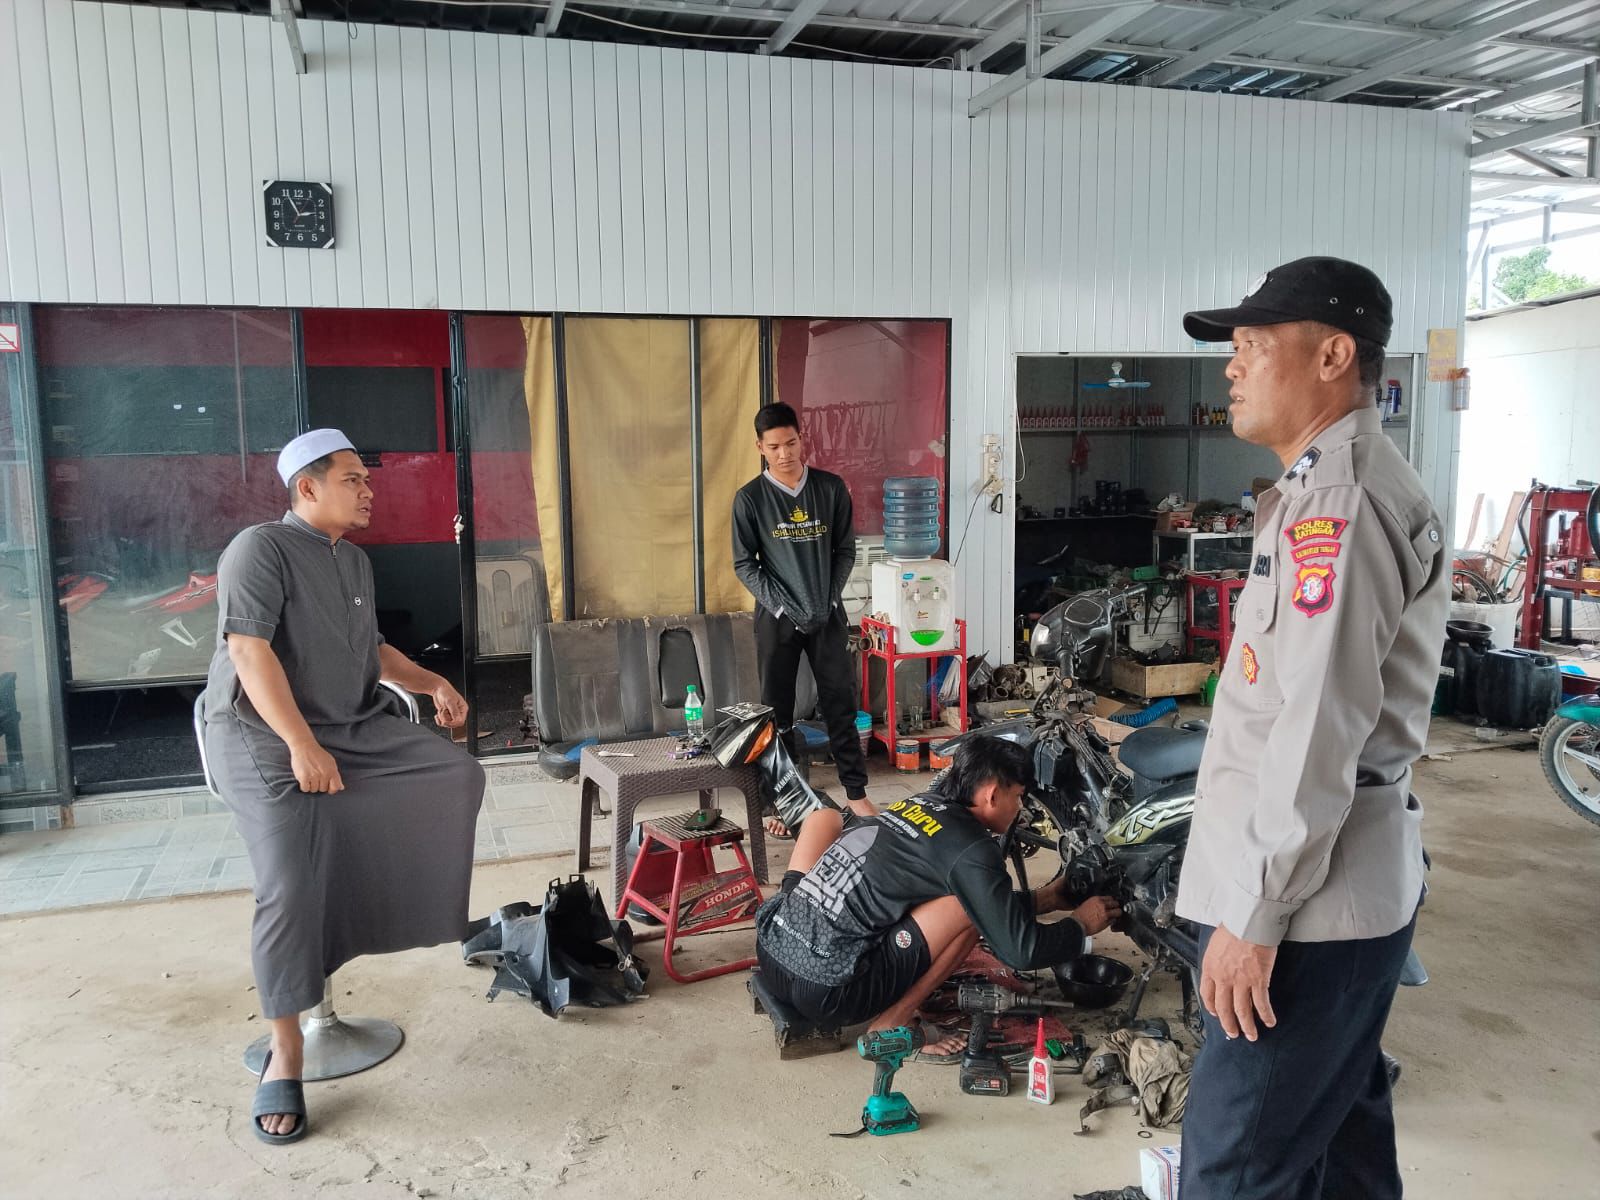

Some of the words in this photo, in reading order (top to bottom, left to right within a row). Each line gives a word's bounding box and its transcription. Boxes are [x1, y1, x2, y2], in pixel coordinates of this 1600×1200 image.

[282, 188, 290, 197] 11
[293, 189, 304, 198] 12
[271, 197, 281, 206] 10
[318, 198, 325, 207] 2
[273, 210, 280, 219] 9
[319, 211, 325, 219] 3
[273, 222, 280, 231] 8
[319, 224, 325, 232] 4
[284, 232, 291, 241] 7
[297, 233, 304, 242] 6
[311, 233, 318, 242] 5
[1294, 520, 1334, 533] POLRES
[774, 768, 796, 793] YAMAHA
[704, 881, 750, 907] HONDA
